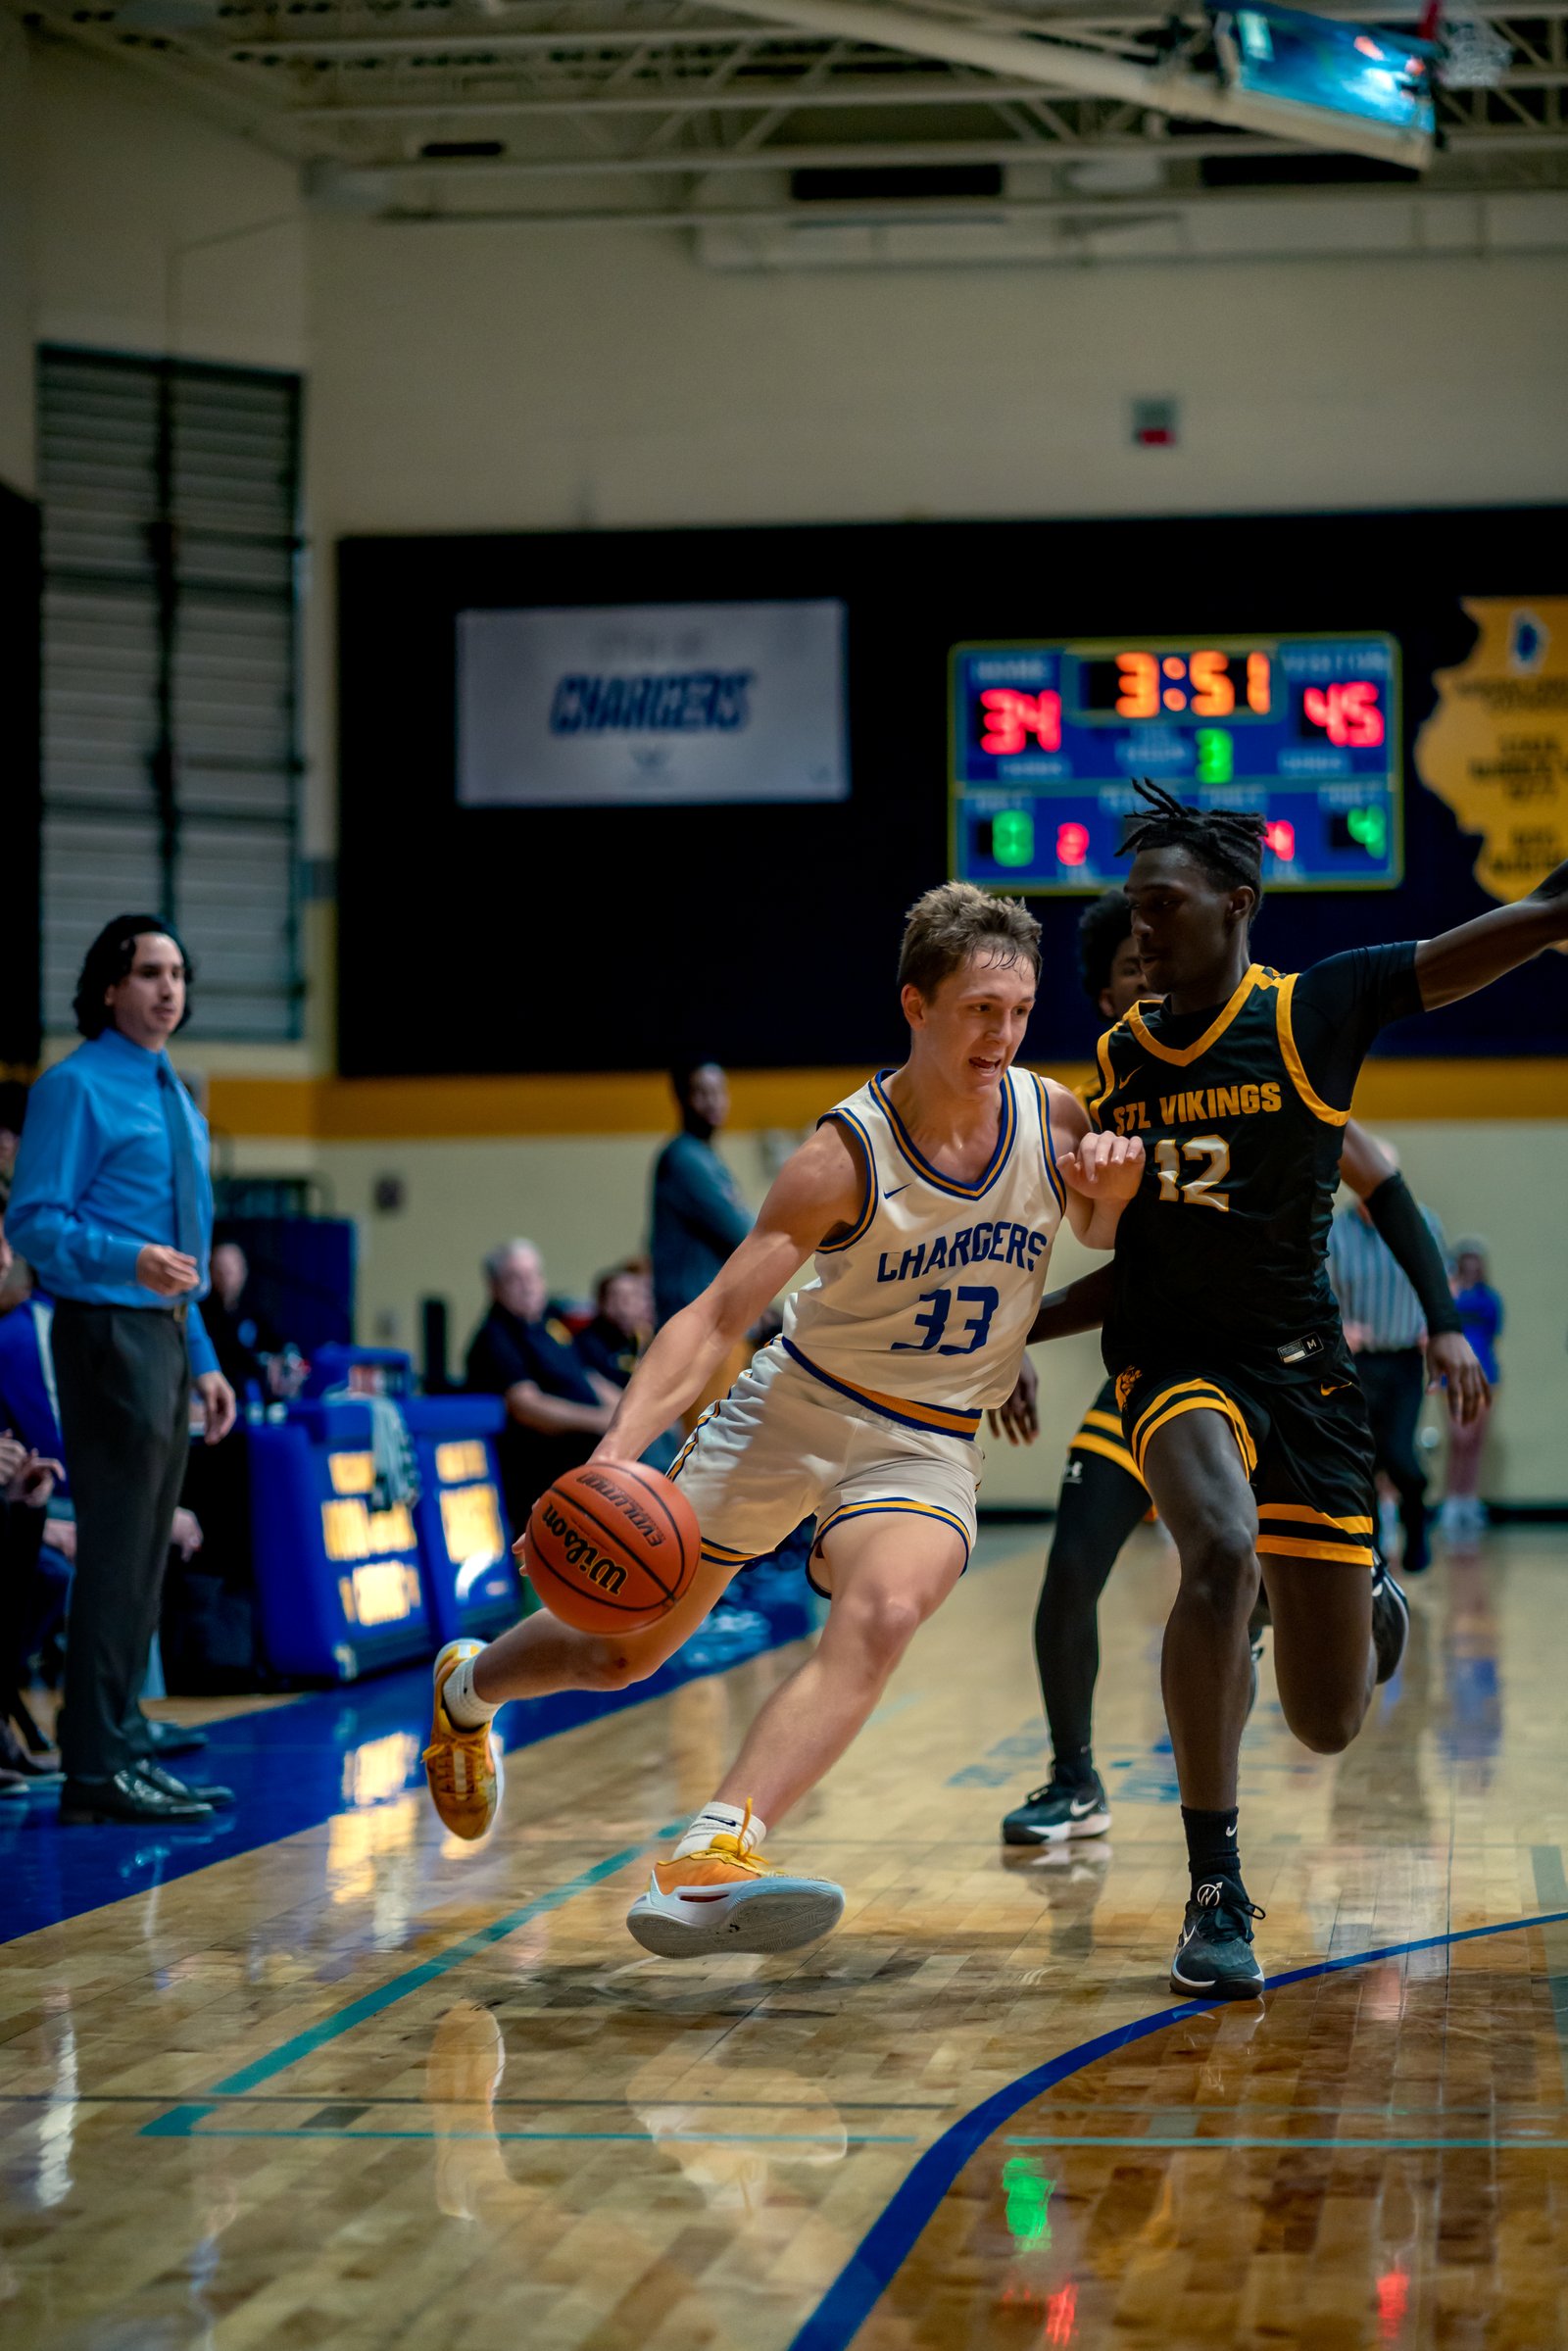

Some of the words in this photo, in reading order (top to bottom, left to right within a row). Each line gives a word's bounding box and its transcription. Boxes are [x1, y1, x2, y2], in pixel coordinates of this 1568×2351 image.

[1115, 652, 1271, 717] 3:51
[1303, 681, 1385, 748] 45
[980, 688, 1062, 755] 34
[1113, 1106, 1151, 1136] STL
[1160, 1082, 1282, 1123] VIKINGS
[1154, 1134, 1231, 1212] 12
[877, 1221, 1048, 1284] CHARGERS
[890, 1286, 999, 1356] 33
[1306, 1339, 1317, 1349] M
[541, 1504, 628, 1597] Wilson
